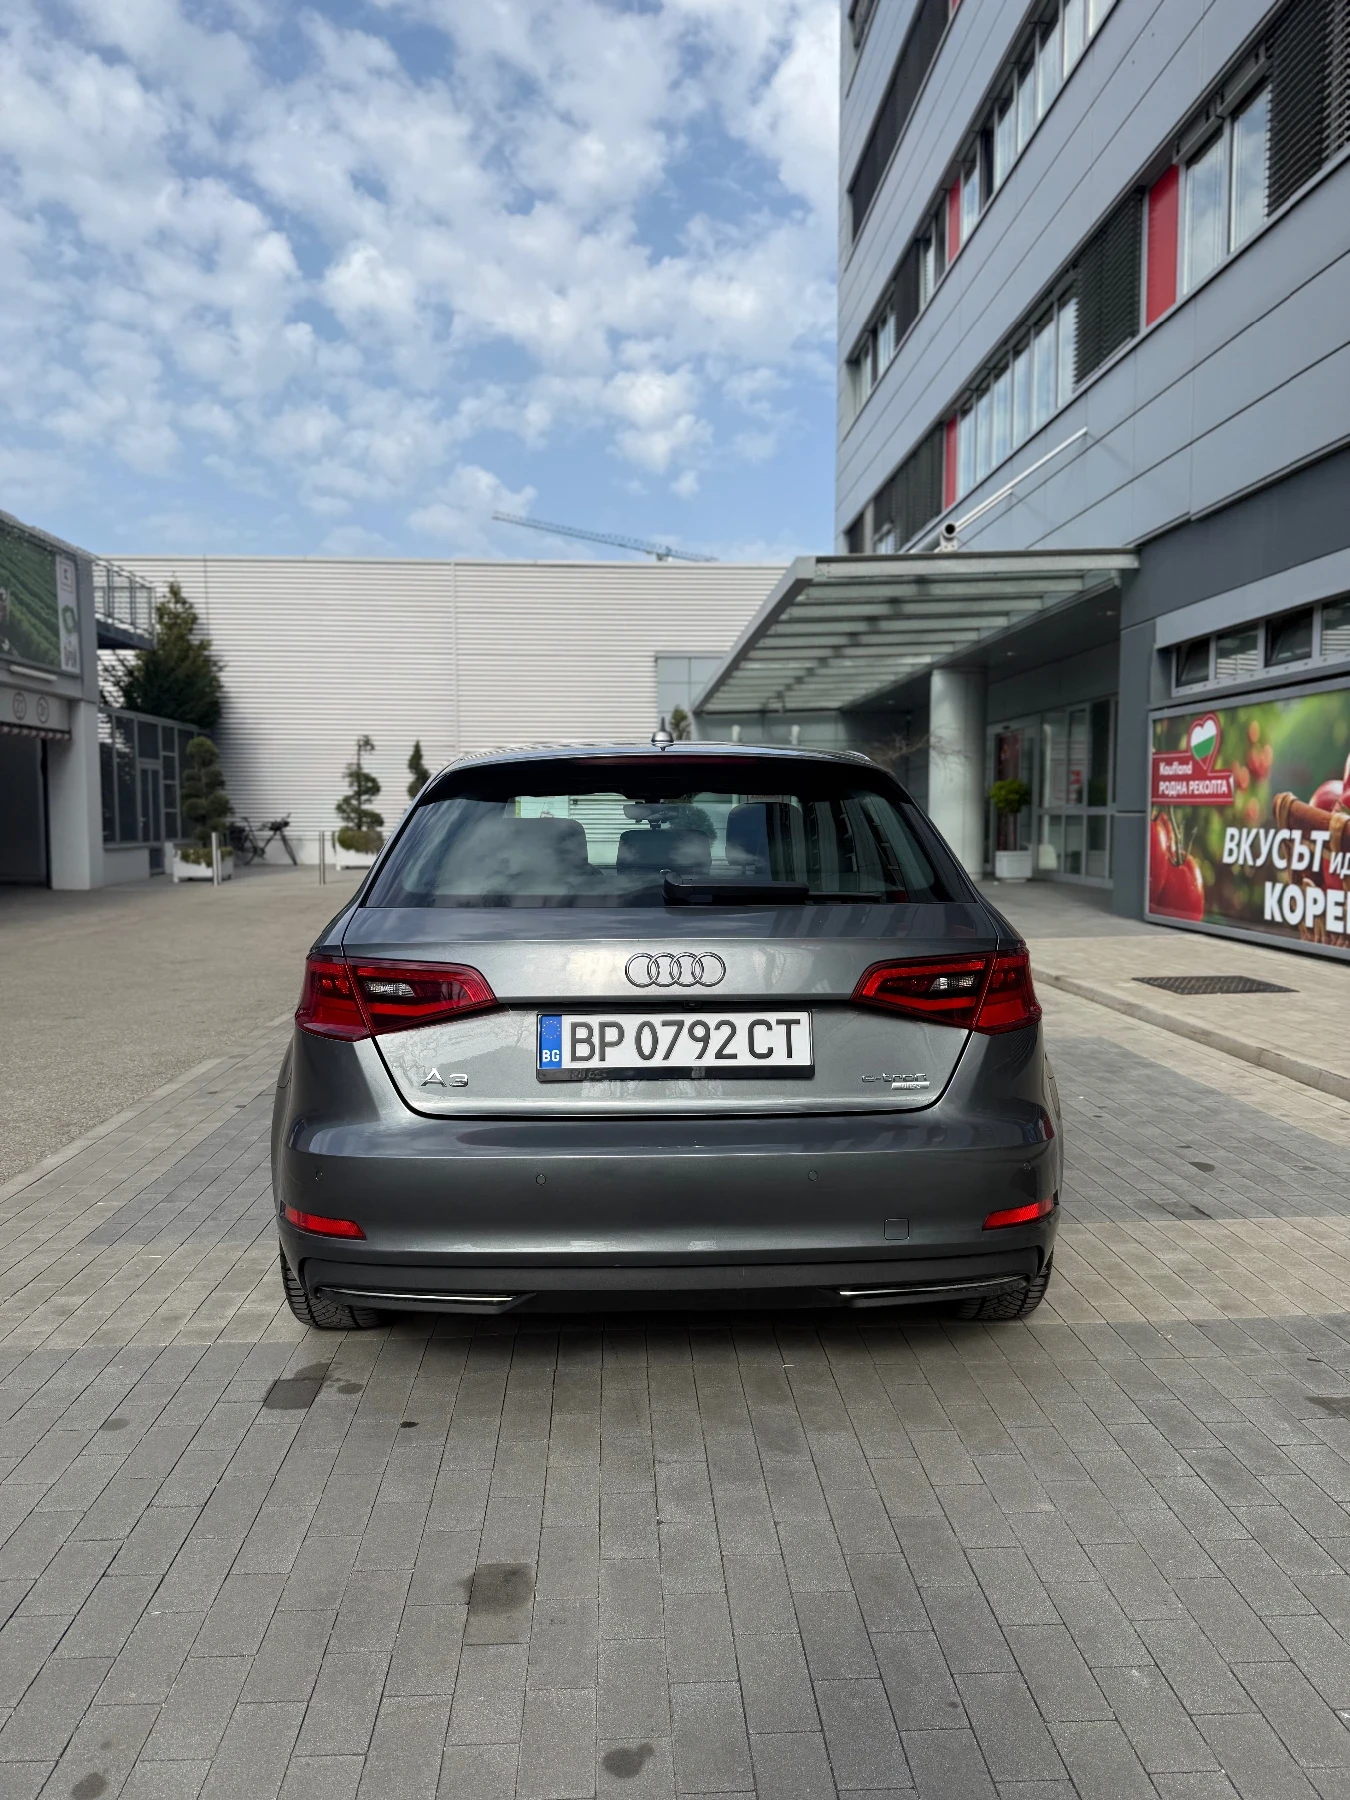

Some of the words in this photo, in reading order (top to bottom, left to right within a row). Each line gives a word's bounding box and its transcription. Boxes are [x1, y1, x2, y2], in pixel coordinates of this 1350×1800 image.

[1159, 762, 1193, 776] Kaufland
[1159, 781, 1187, 796] РОДНА
[1188, 778, 1228, 794] РЕКОЛТА
[1222, 826, 1331, 873] ВКУСЪТ
[1263, 881, 1350, 935] КОРЕ
[634, 1019, 738, 1061] 0792
[542, 1049, 560, 1062] BG
[420, 1067, 469, 1088] A3
[861, 1073, 927, 1083] e-tron
